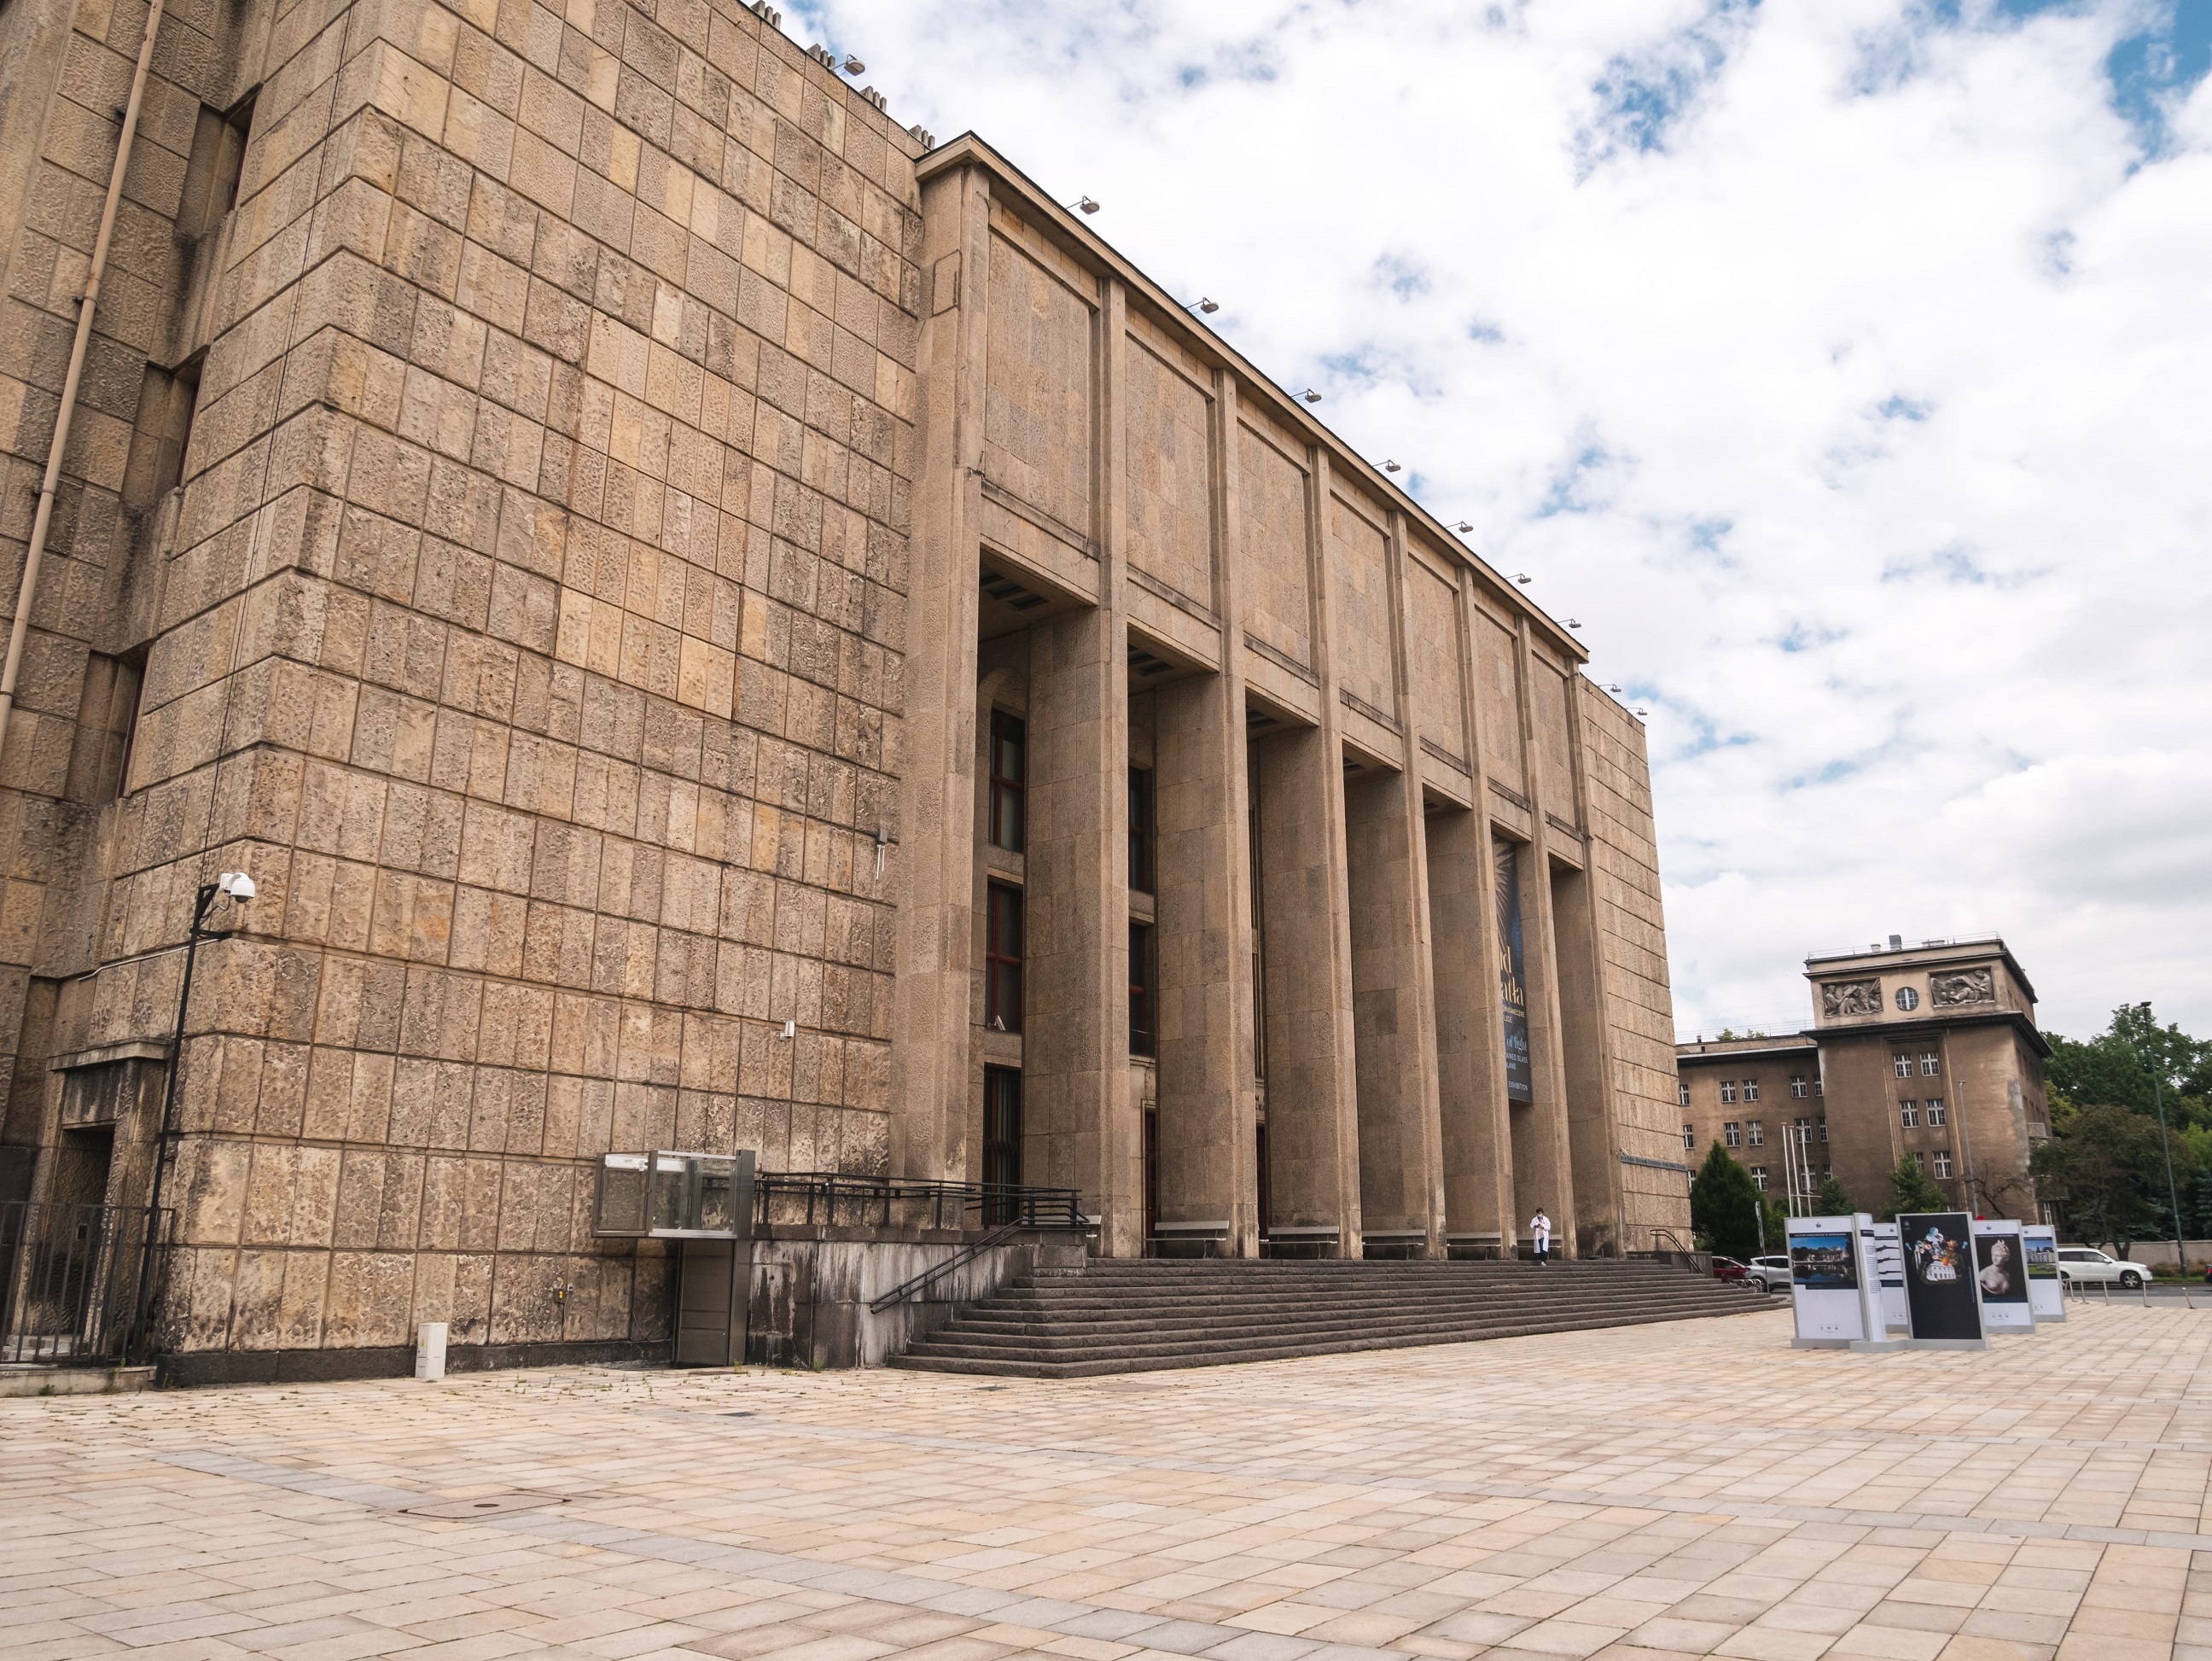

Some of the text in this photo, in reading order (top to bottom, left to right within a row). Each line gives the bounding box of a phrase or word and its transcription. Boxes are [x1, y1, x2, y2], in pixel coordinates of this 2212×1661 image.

[1506, 1034, 1527, 1053] of light
[1517, 1055, 1528, 1064] GLASS
[1509, 1081, 1528, 1092] EXHIBITION
